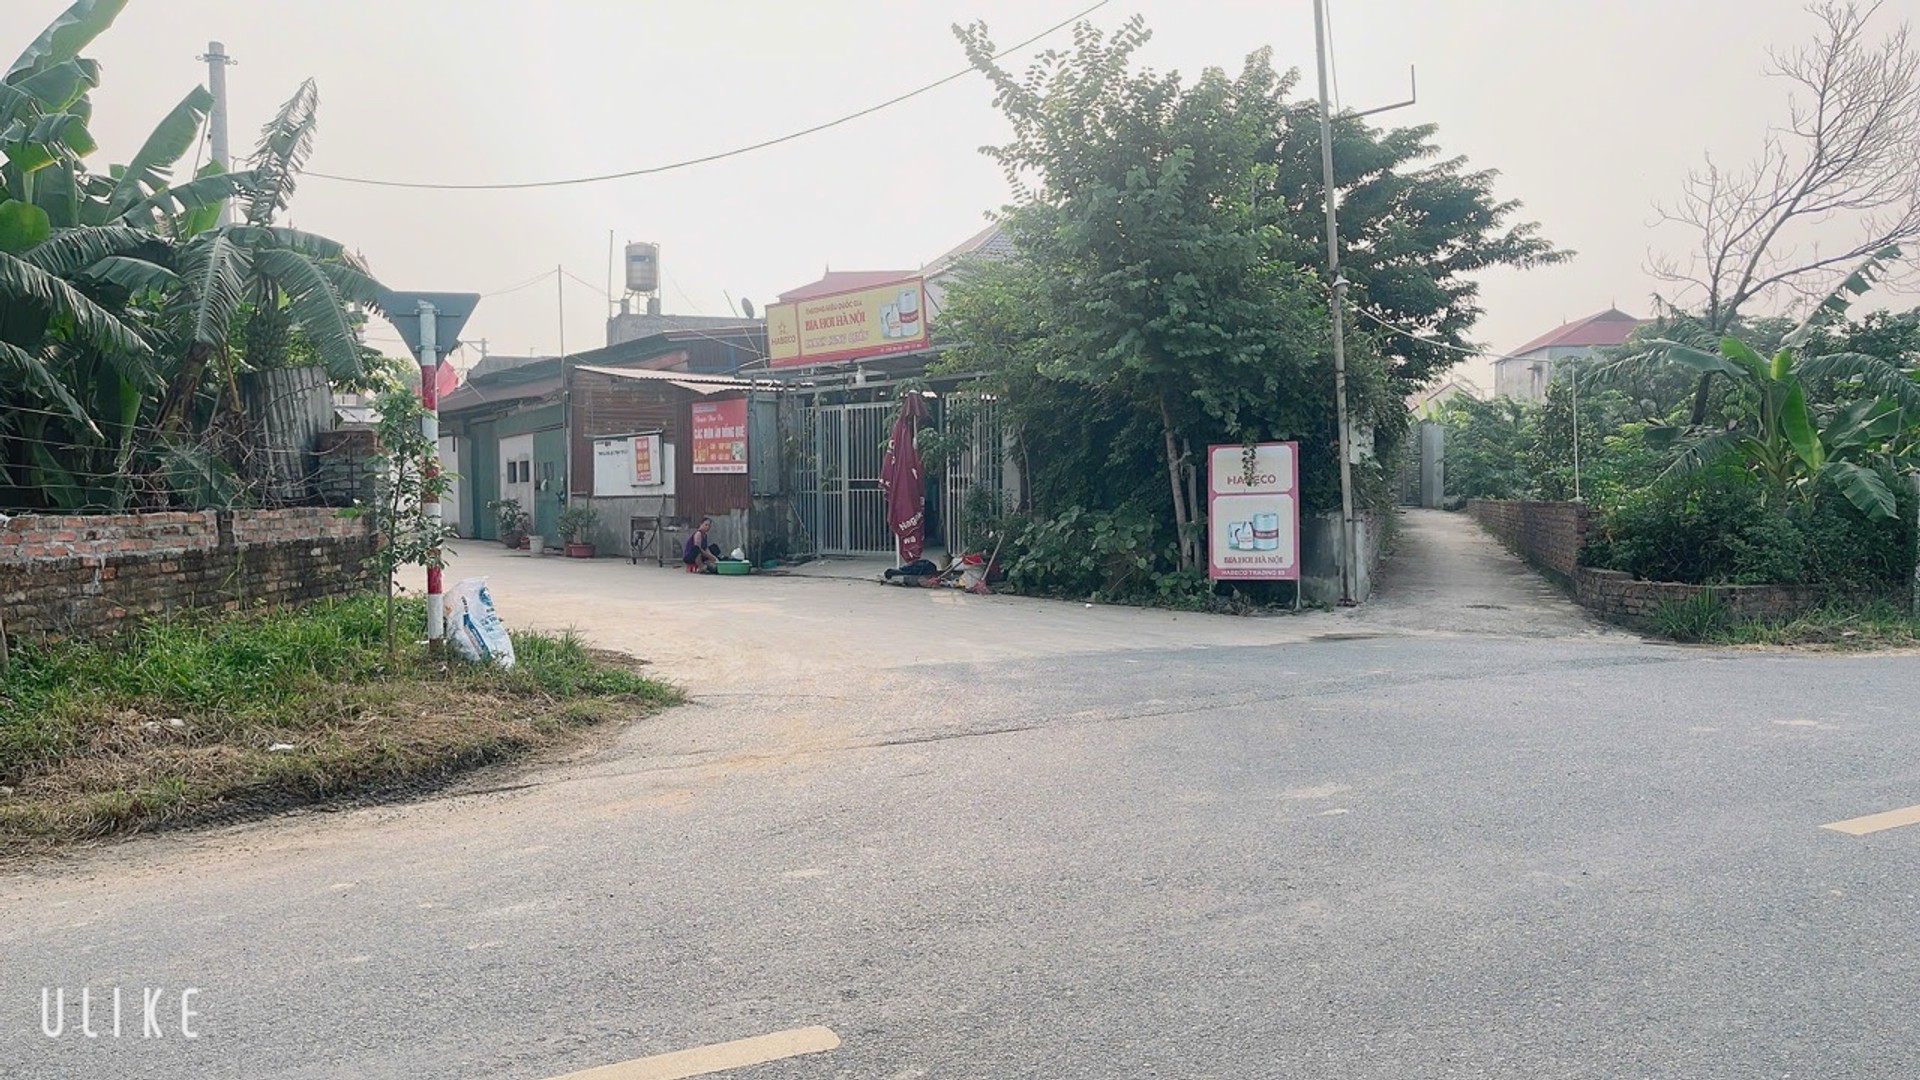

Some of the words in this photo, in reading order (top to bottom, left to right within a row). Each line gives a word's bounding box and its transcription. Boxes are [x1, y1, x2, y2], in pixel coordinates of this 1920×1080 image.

[805, 320, 819, 332] BIA
[819, 316, 835, 330] HƠI
[835, 311, 849, 327] HÀ
[849, 308, 866, 326] NỘI
[771, 335, 796, 346] HABECO
[1226, 474, 1277, 485] HAECO
[1254, 554, 1268, 564] HÀ
[1268, 554, 1284, 565] NỘI
